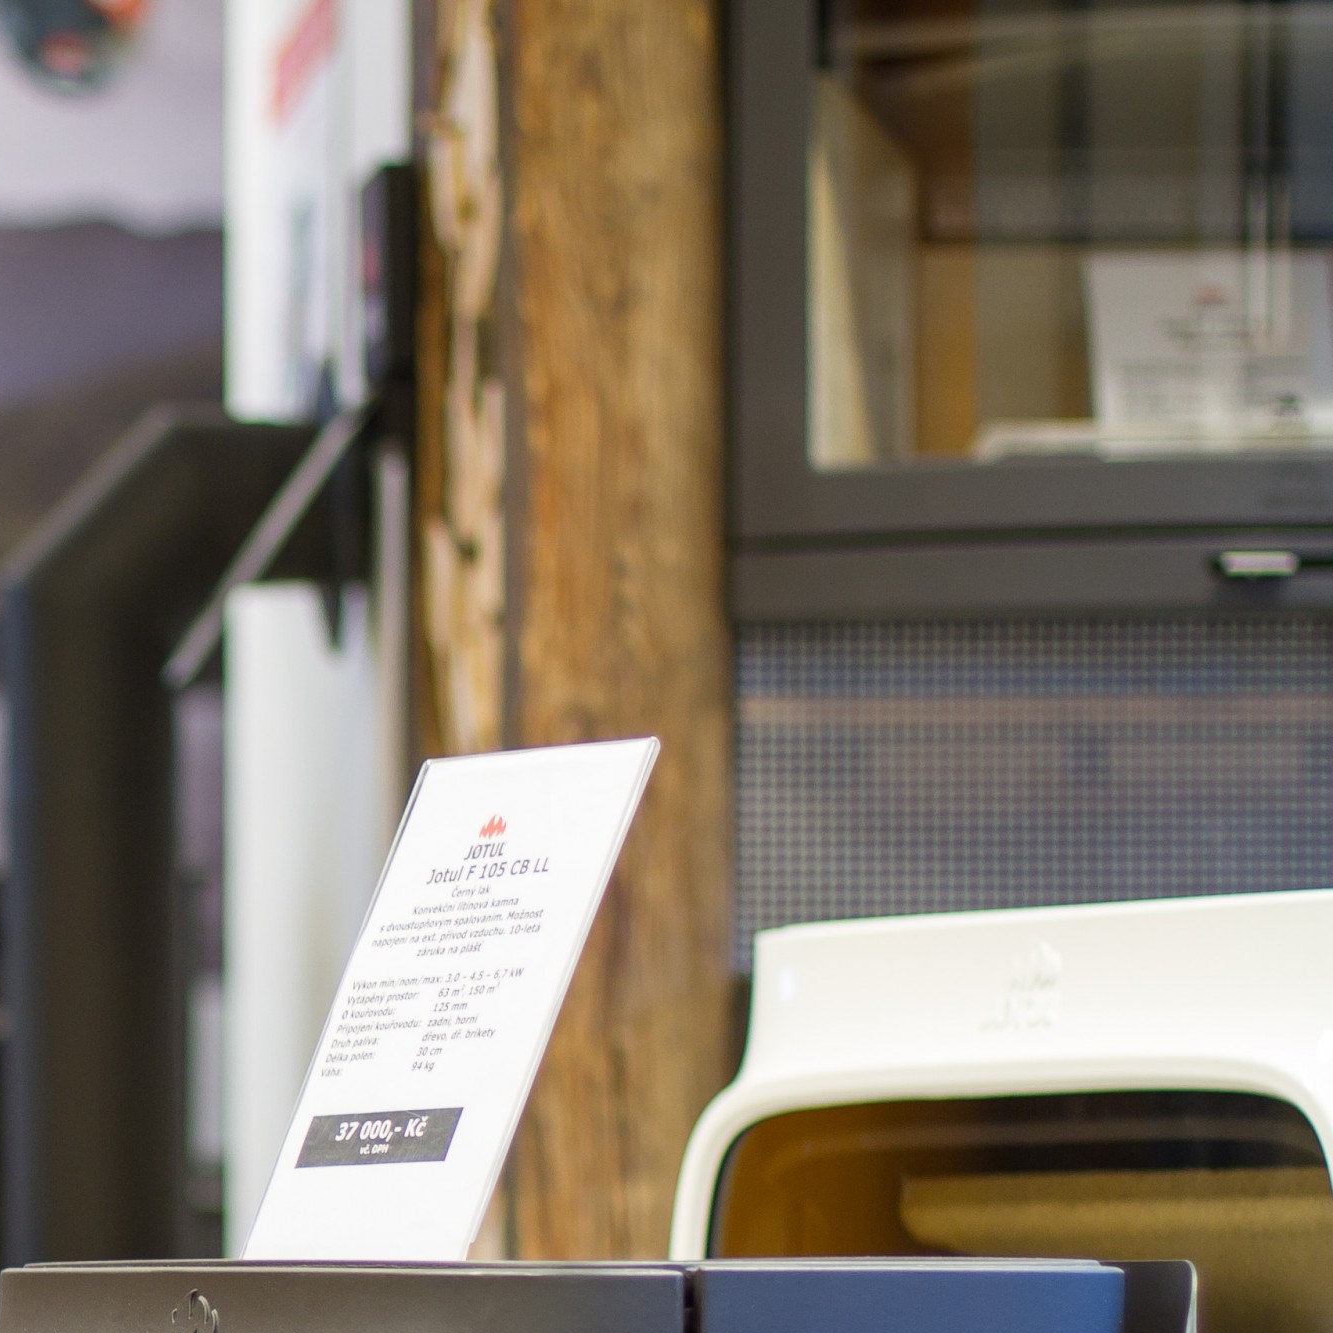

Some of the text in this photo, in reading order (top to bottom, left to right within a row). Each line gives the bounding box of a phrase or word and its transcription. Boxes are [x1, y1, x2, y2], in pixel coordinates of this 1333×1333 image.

[426, 857, 549, 885] Jotul F 105 CB LL
[451, 885, 490, 898] Černý lak
[412, 902, 456, 915] Konvekční
[491, 898, 519, 906] kamna
[507, 909, 544, 920] Možnost
[372, 936, 408, 948] napojení
[422, 934, 437, 942] ext.
[439, 930, 467, 944] přívod
[469, 928, 506, 938] vzduchu.
[510, 923, 541, 934] 10-letá
[417, 947, 445, 957] záruka
[352, 980, 377, 993] Výkon
[445, 972, 460, 983] 3,0
[470, 970, 484, 981] 4,5
[493, 969, 508, 980] 6,7
[509, 967, 524, 977] kW
[386, 992, 420, 1003] prostor:
[438, 988, 450, 998] 63
[468, 985, 485, 995] 150
[433, 1002, 450, 1012] 125
[451, 1002, 468, 1010] mm
[331, 1039, 351, 1049] Druh
[352, 1036, 380, 1049] paliva:
[465, 1028, 496, 1039] brikety
[325, 1046, 442, 1063] Délka polen: 30 cm
[321, 1060, 435, 1077] Váha: 94 kg
[335, 1116, 429, 1142] 37 000,- Kč
[359, 1143, 390, 1156] vč. DPH
